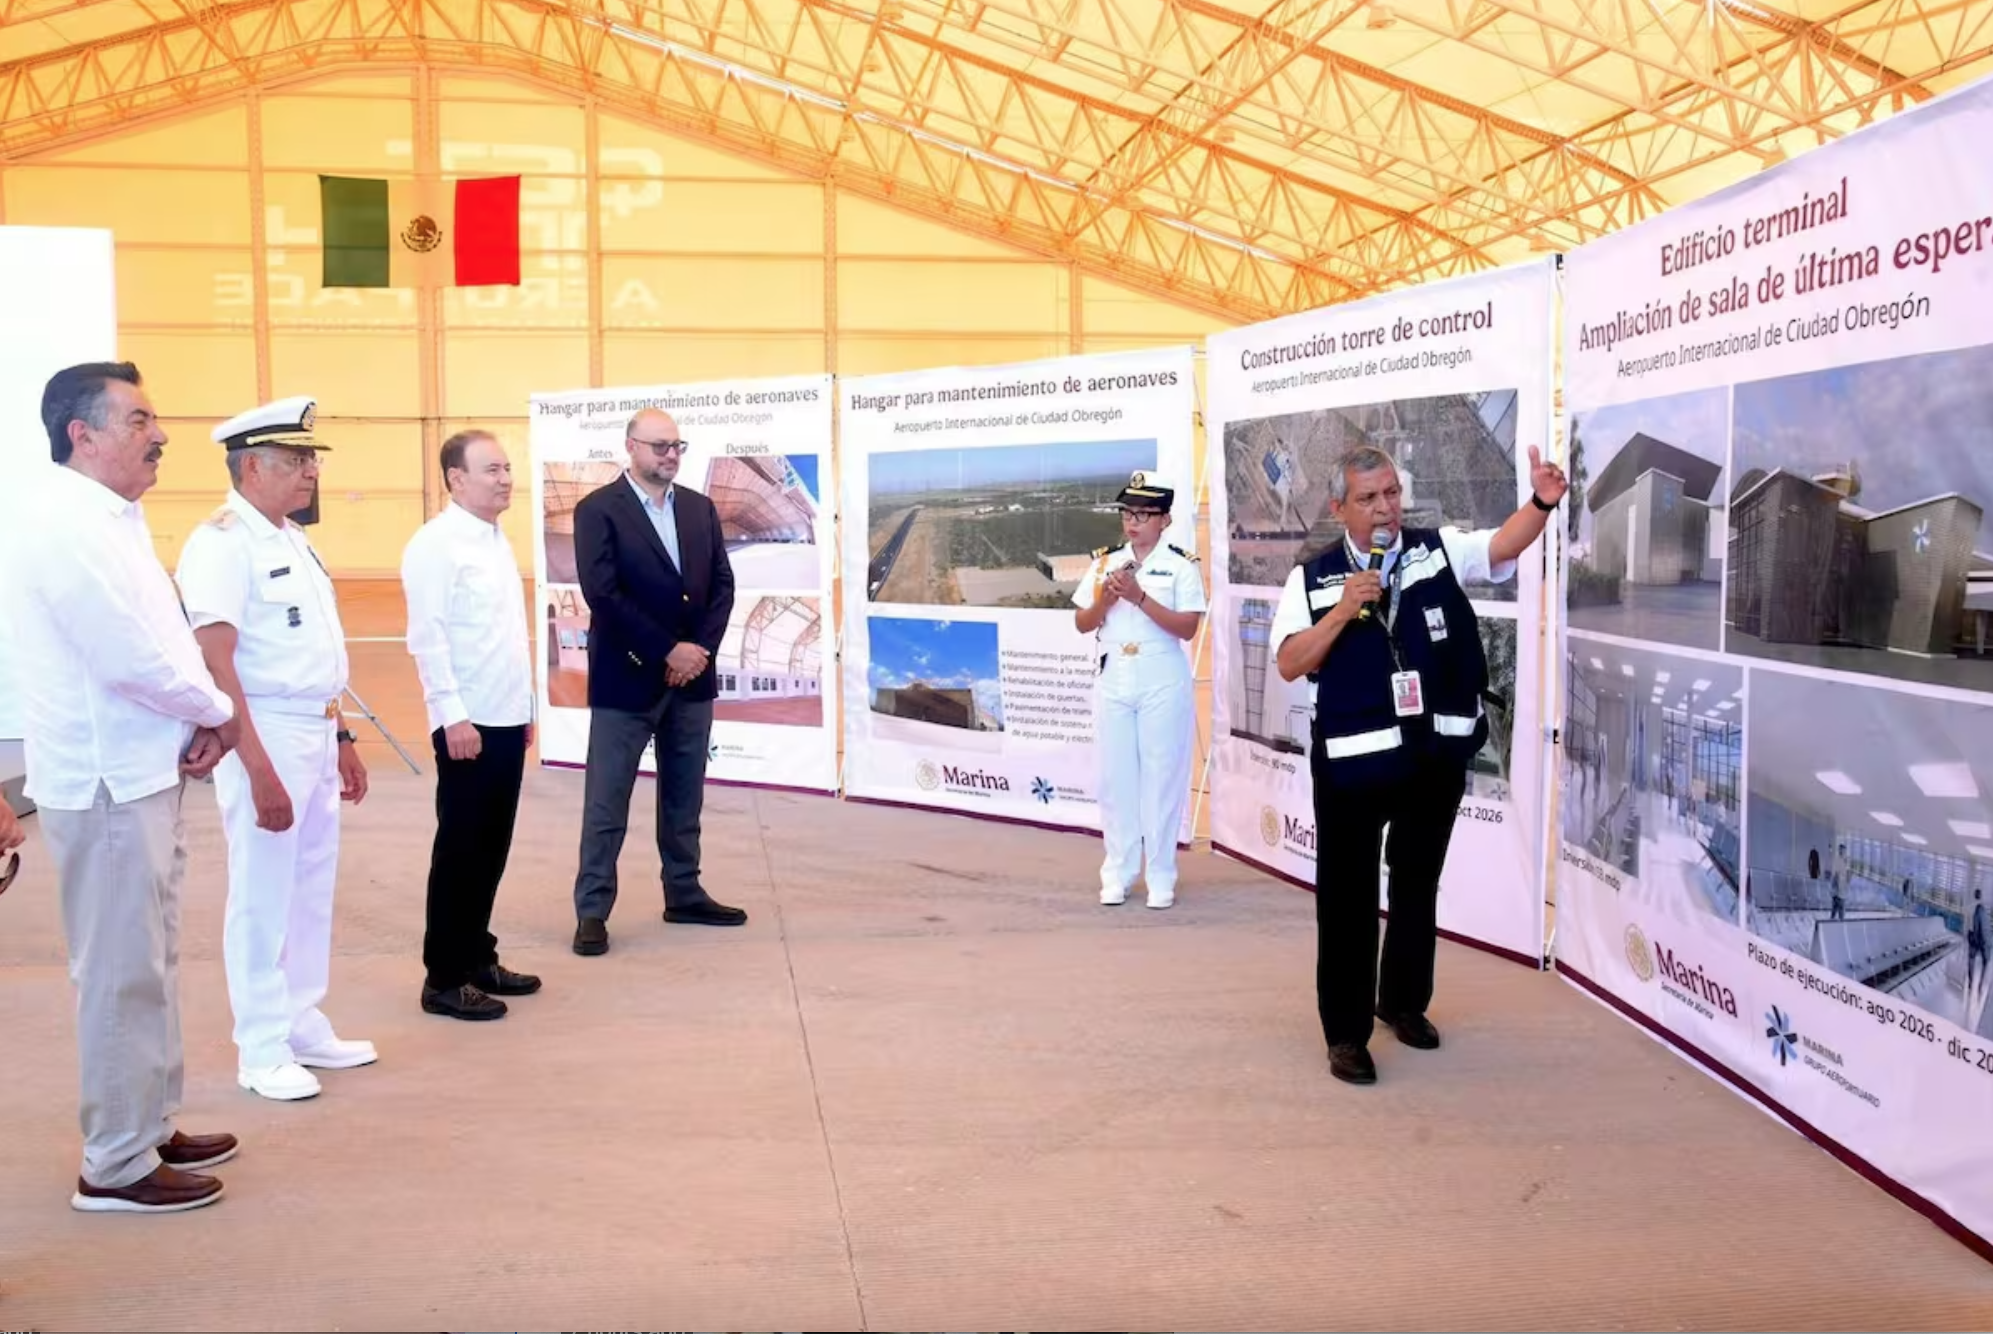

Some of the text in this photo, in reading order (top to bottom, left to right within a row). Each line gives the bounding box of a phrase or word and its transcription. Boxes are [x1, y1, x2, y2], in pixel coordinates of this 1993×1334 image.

[1661, 176, 1847, 277] Edificio terminal
[1579, 216, 1993, 352] Ampliación de sala de última esper
[1241, 300, 1492, 371] Construcción torre de control
[1617, 291, 1930, 379] Aeropuerto Internacional de Ciudad Obregón
[1299, 361, 1363, 386] Internacional
[1364, 360, 1377, 376] de
[1380, 352, 1419, 374] Ciudad
[1421, 345, 1472, 369] Obregón
[539, 388, 819, 418] Hangar para mantenimiento de aeronaves
[851, 370, 1178, 413] Hangar para mantenimiento de aeronaves
[893, 406, 1122, 433] Aeropuerto Internacional de Ciudad Obregón
[726, 442, 770, 456] Después
[943, 764, 1010, 791] Marina
[1284, 814, 1316, 851] Mari
[1474, 806, 1503, 824] 2026
[1654, 940, 1739, 1019] Marina
[1747, 942, 1778, 970] Plazo
[1780, 957, 1794, 979] de
[1797, 967, 1864, 1011] ejecución:
[1866, 1000, 1896, 1024] ago
[1899, 1009, 1936, 1044] 2026
[1947, 1036, 1972, 1064] dic
